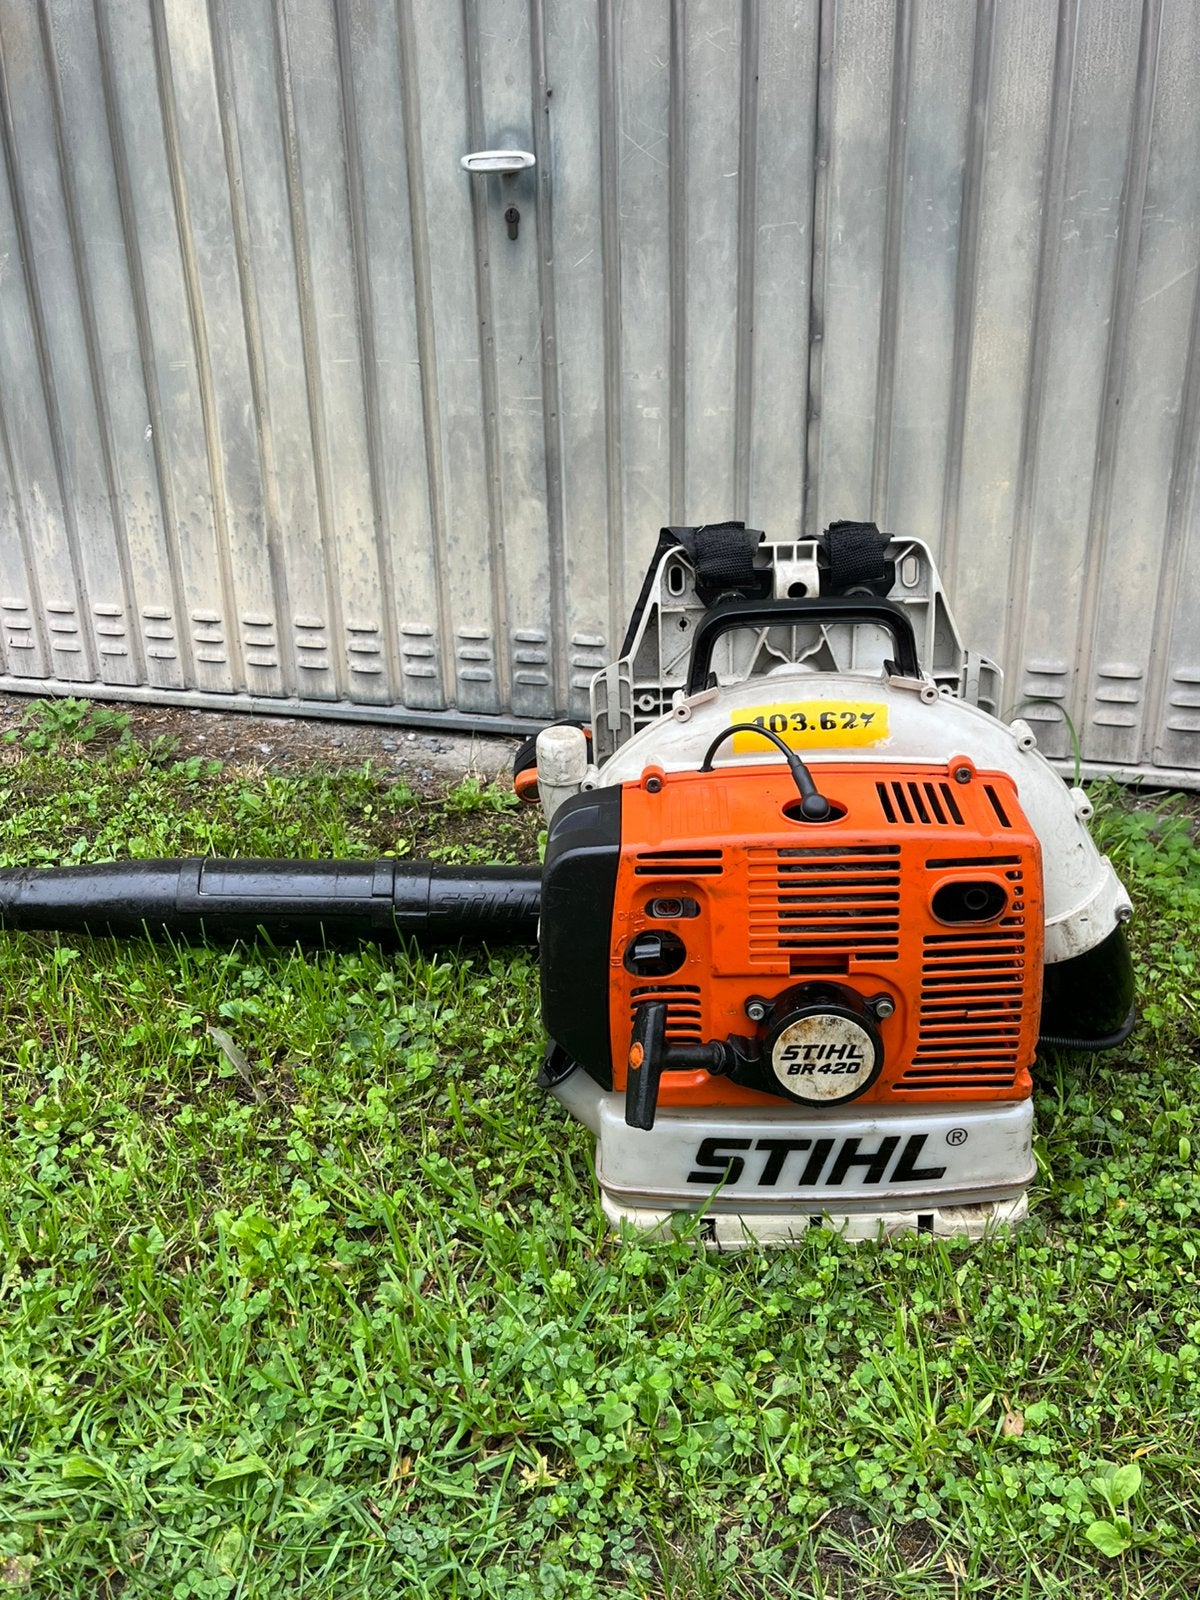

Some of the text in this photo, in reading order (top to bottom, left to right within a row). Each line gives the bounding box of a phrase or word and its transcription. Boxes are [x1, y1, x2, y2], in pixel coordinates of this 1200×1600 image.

[780, 1043, 865, 1061] STIHL
[787, 1062, 861, 1075] BR 420
[686, 1133, 947, 1186] STIHL
